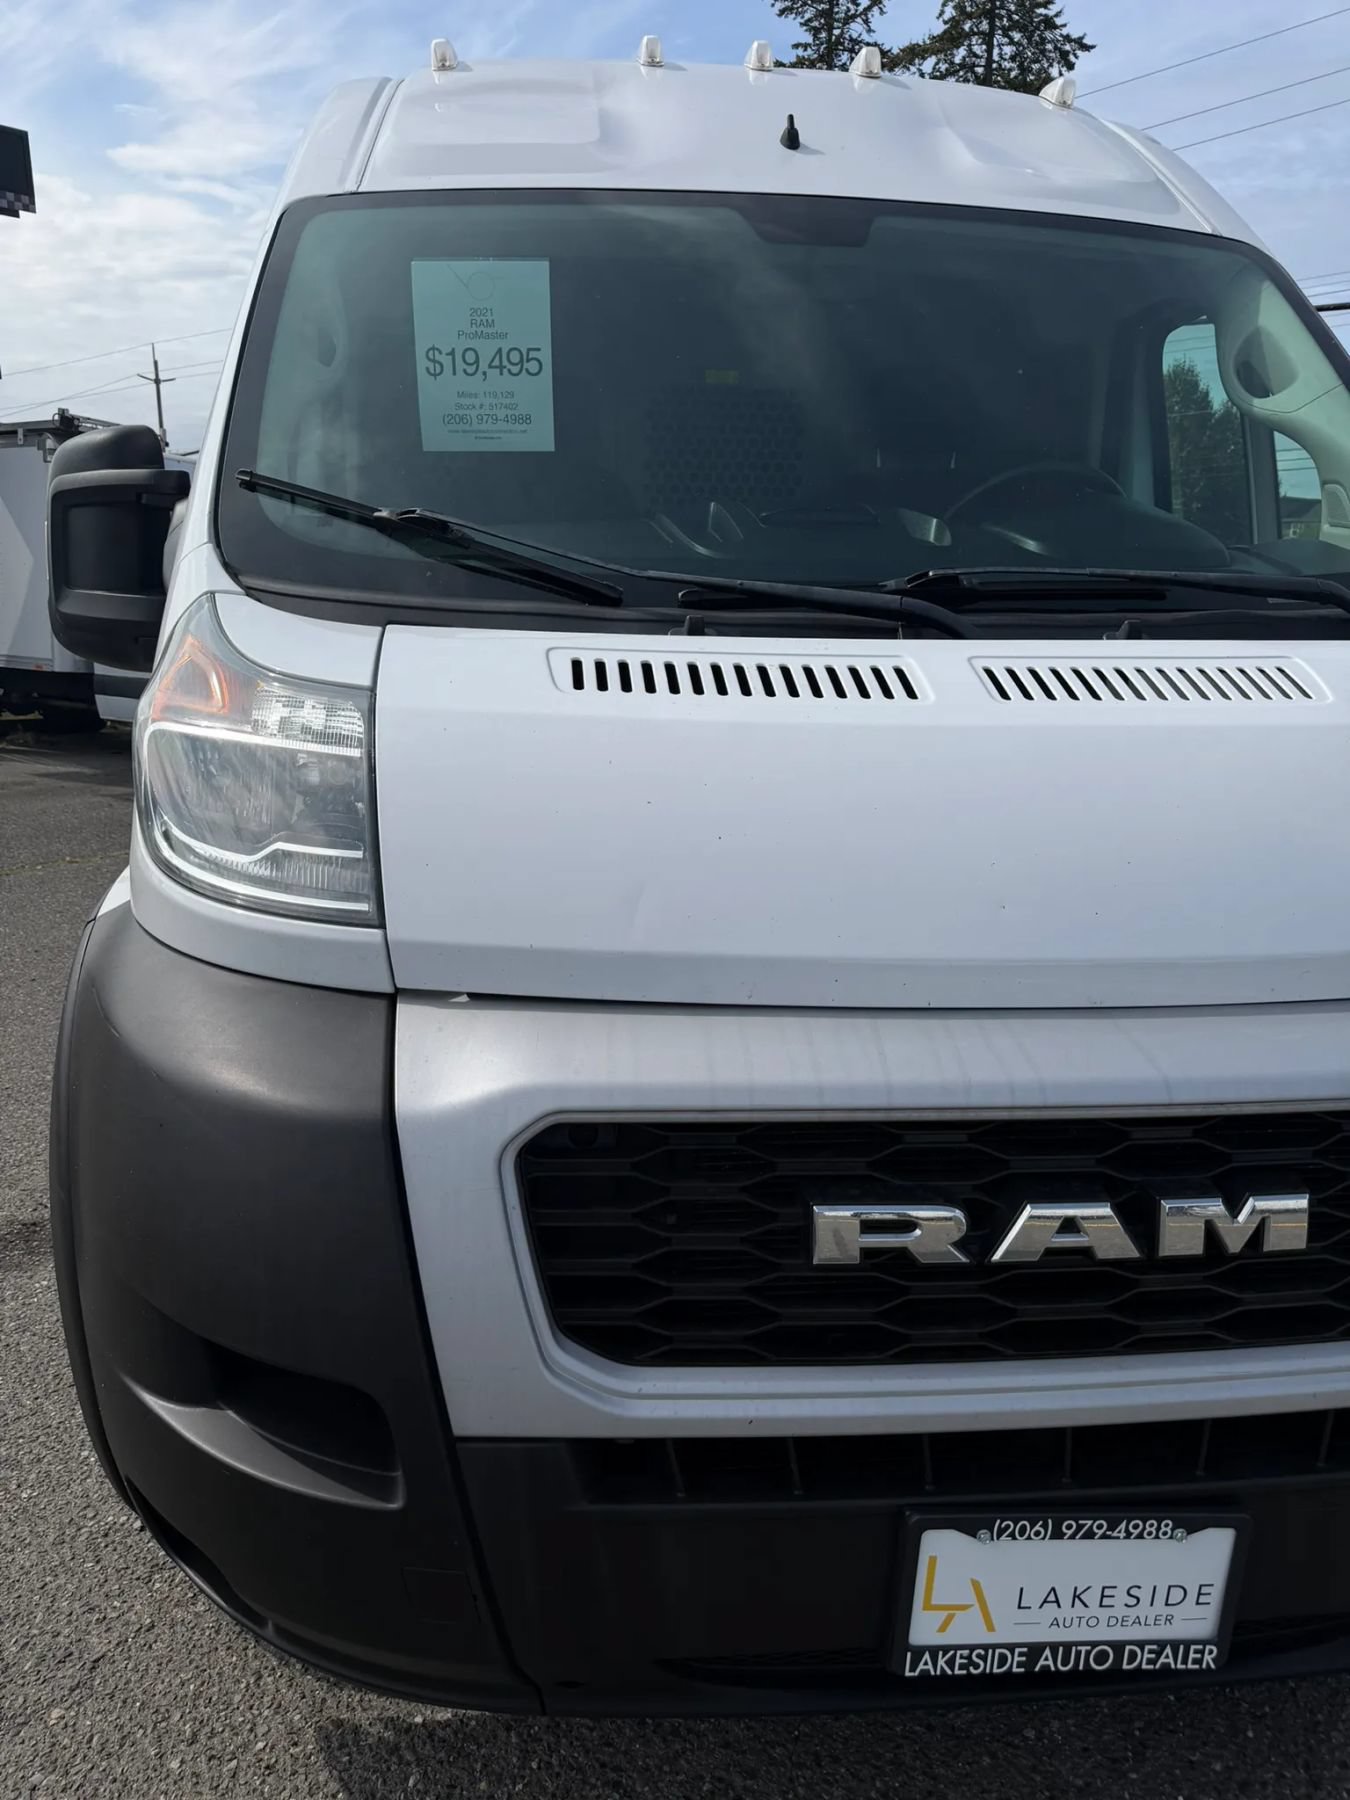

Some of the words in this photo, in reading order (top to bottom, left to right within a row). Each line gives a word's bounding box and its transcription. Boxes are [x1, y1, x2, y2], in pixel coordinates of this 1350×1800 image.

[469, 307, 494, 317] 2021
[470, 318, 495, 328] RAM
[457, 330, 509, 340] ProMaster
[425, 344, 543, 381] $19,495
[457, 391, 480, 399] Miles:
[454, 402, 477, 411] Stock
[442, 413, 473, 427] (206)
[476, 413, 532, 425] 979-4988
[812, 1193, 1310, 1265] RAM
[993, 1518, 1052, 1542] (206)
[1061, 1519, 1173, 1540] 979-4988
[1017, 1583, 1215, 1610] LAKESIDE
[1048, 1615, 1100, 1629] AUTO
[1106, 1614, 1175, 1628] DEALER
[904, 1647, 1028, 1677] LAKESIDE
[1035, 1646, 1113, 1671] AUTO
[1122, 1644, 1218, 1670] DEALER
